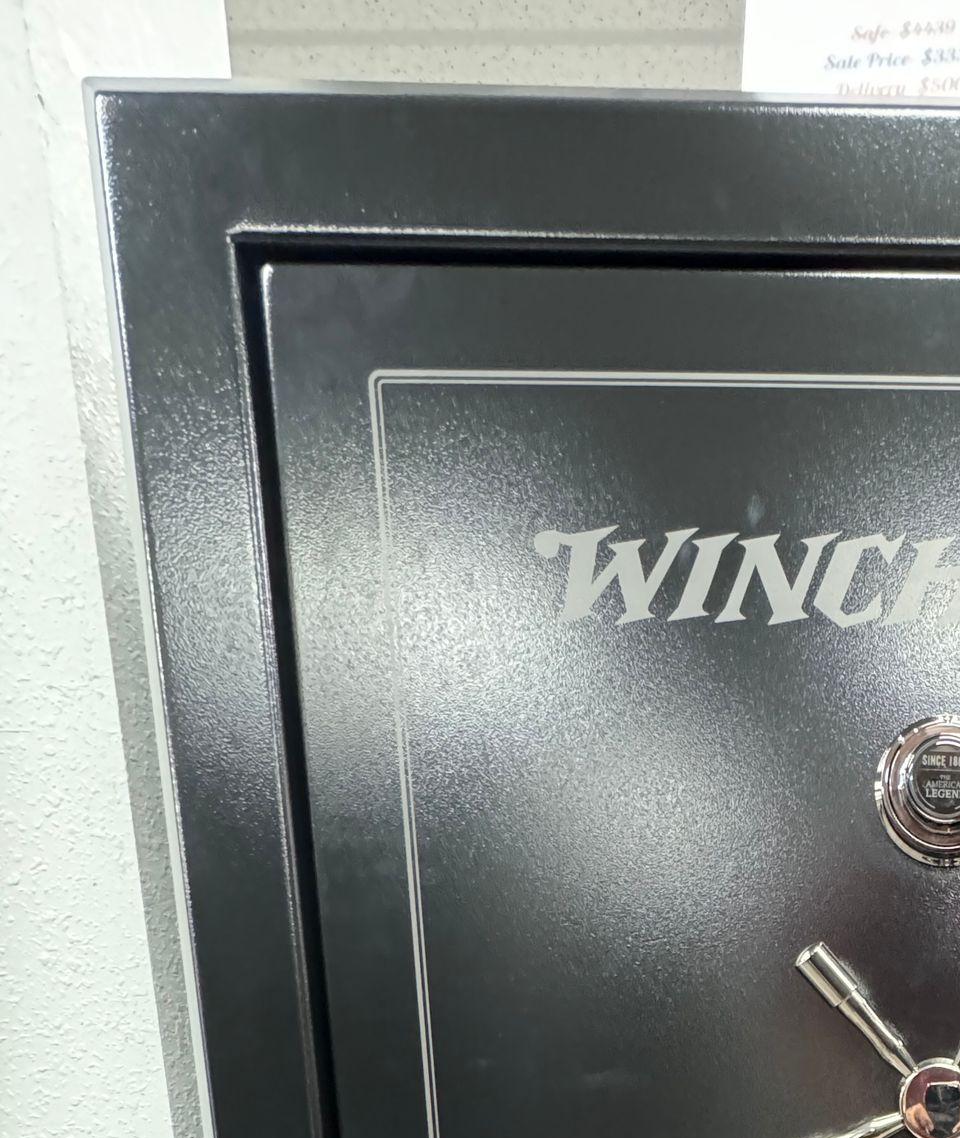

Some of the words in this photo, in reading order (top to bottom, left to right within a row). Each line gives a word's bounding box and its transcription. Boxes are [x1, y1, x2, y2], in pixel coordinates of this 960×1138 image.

[850, 24, 889, 44] Safe
[899, 18, 956, 39] $4439
[824, 53, 861, 70] Sale
[866, 51, 911, 68] Price
[922, 754, 946, 766] SINCE
